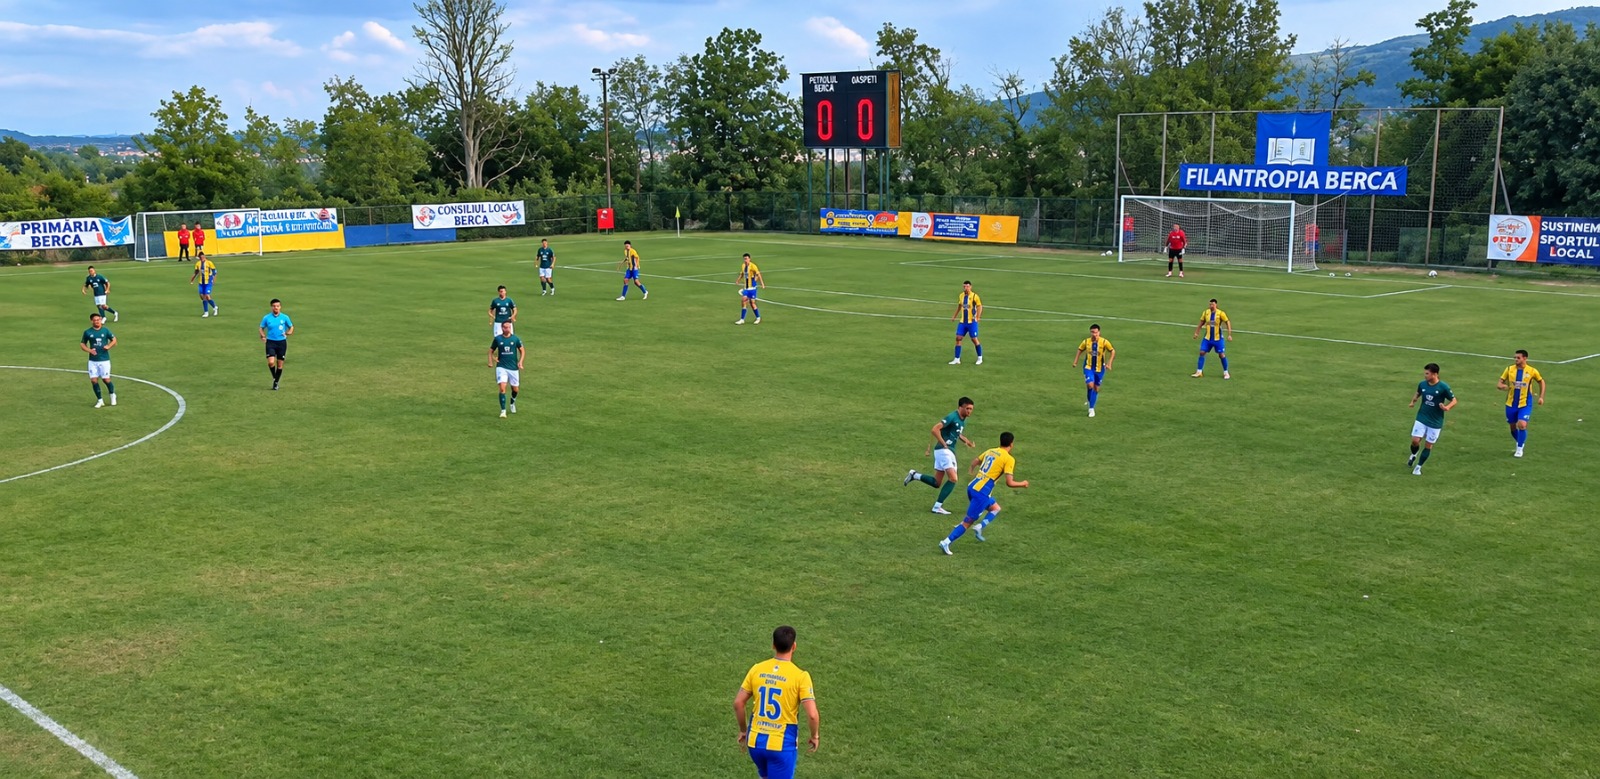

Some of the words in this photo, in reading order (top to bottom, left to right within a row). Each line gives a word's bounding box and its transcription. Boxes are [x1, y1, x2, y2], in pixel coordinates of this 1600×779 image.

[809, 75, 838, 84] PETROLUL
[817, 99, 833, 141] 0
[857, 98, 873, 140] 0
[1186, 168, 1320, 189] FILANTROPIA
[1325, 170, 1398, 190] BERCA
[438, 204, 487, 215] CONSILIUL
[488, 203, 519, 213] LOCAL
[454, 214, 489, 226] BERCA
[1541, 221, 1600, 233] SUSTINEM
[31, 234, 83, 248] BERCA
[1540, 235, 1600, 247] SPORTUL
[1550, 246, 1594, 259] LOCAL
[758, 686, 782, 720] 15
